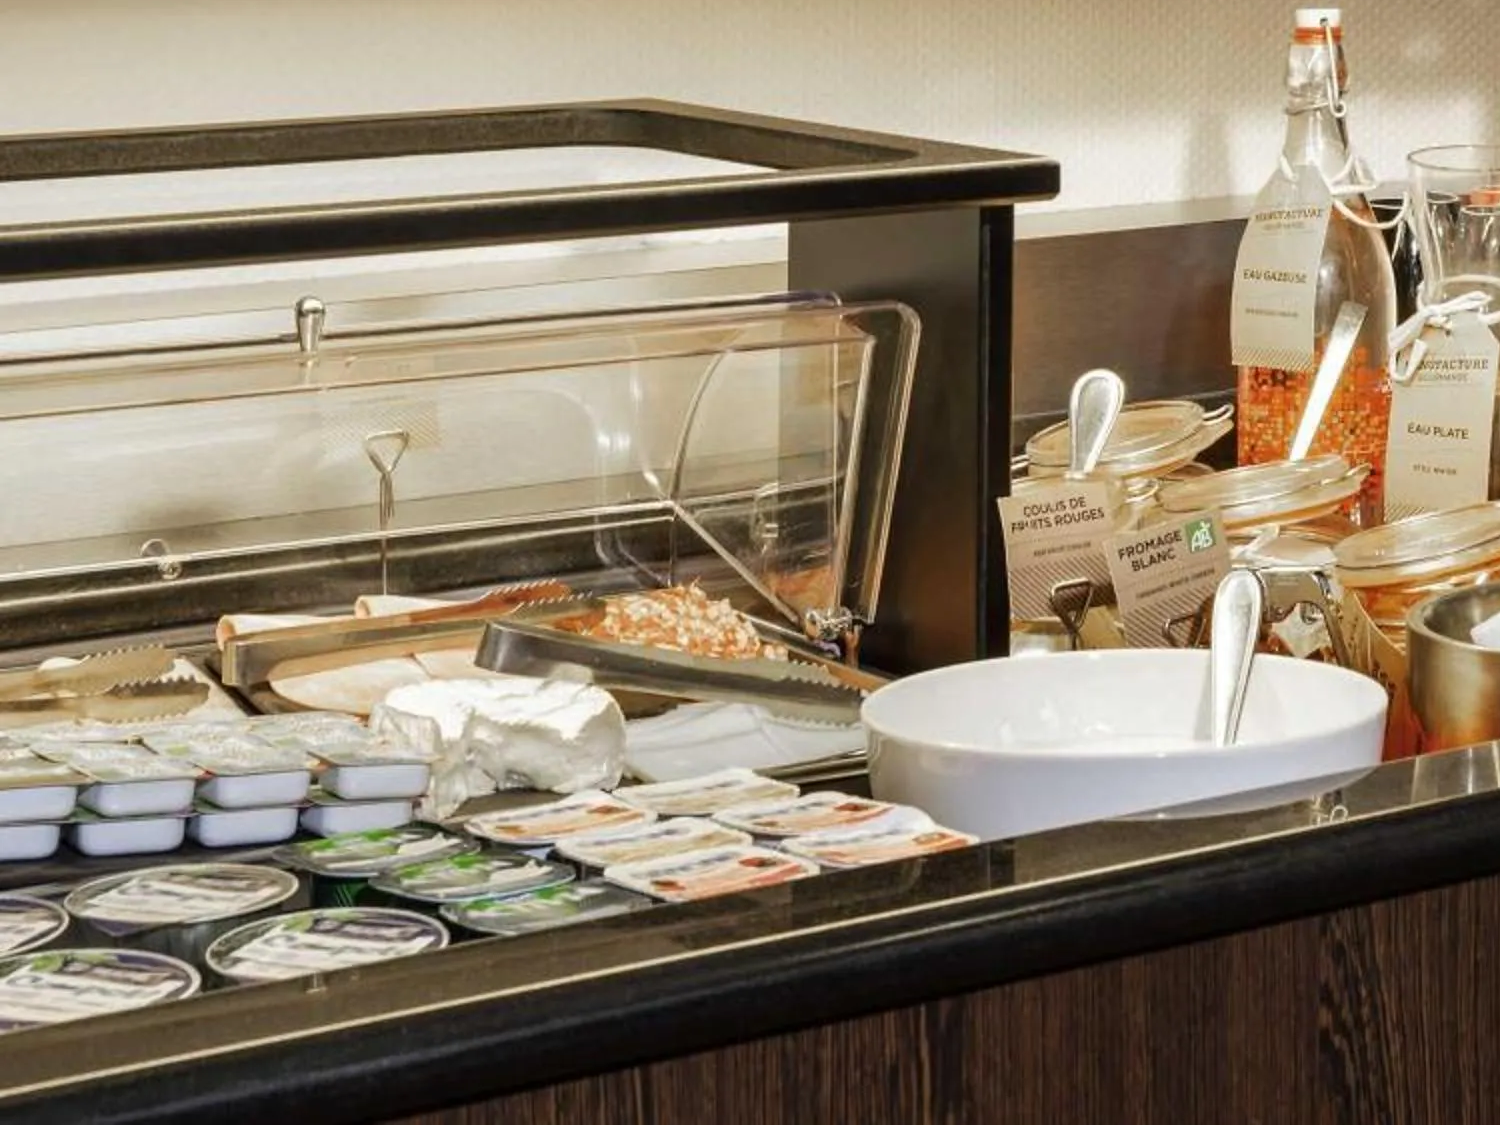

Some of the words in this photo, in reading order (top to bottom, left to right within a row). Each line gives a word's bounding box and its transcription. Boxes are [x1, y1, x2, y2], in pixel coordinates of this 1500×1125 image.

[1243, 268, 1261, 280] EAU
[1407, 422, 1431, 435] EAU
[1433, 426, 1470, 440] PLATE
[1023, 499, 1066, 518] COULIS
[1068, 496, 1087, 509] DE
[1011, 516, 1052, 534] FRUITS
[1054, 506, 1105, 526] ROUGES
[1117, 529, 1183, 560] FROMAGE
[1131, 548, 1177, 572] BLANC
